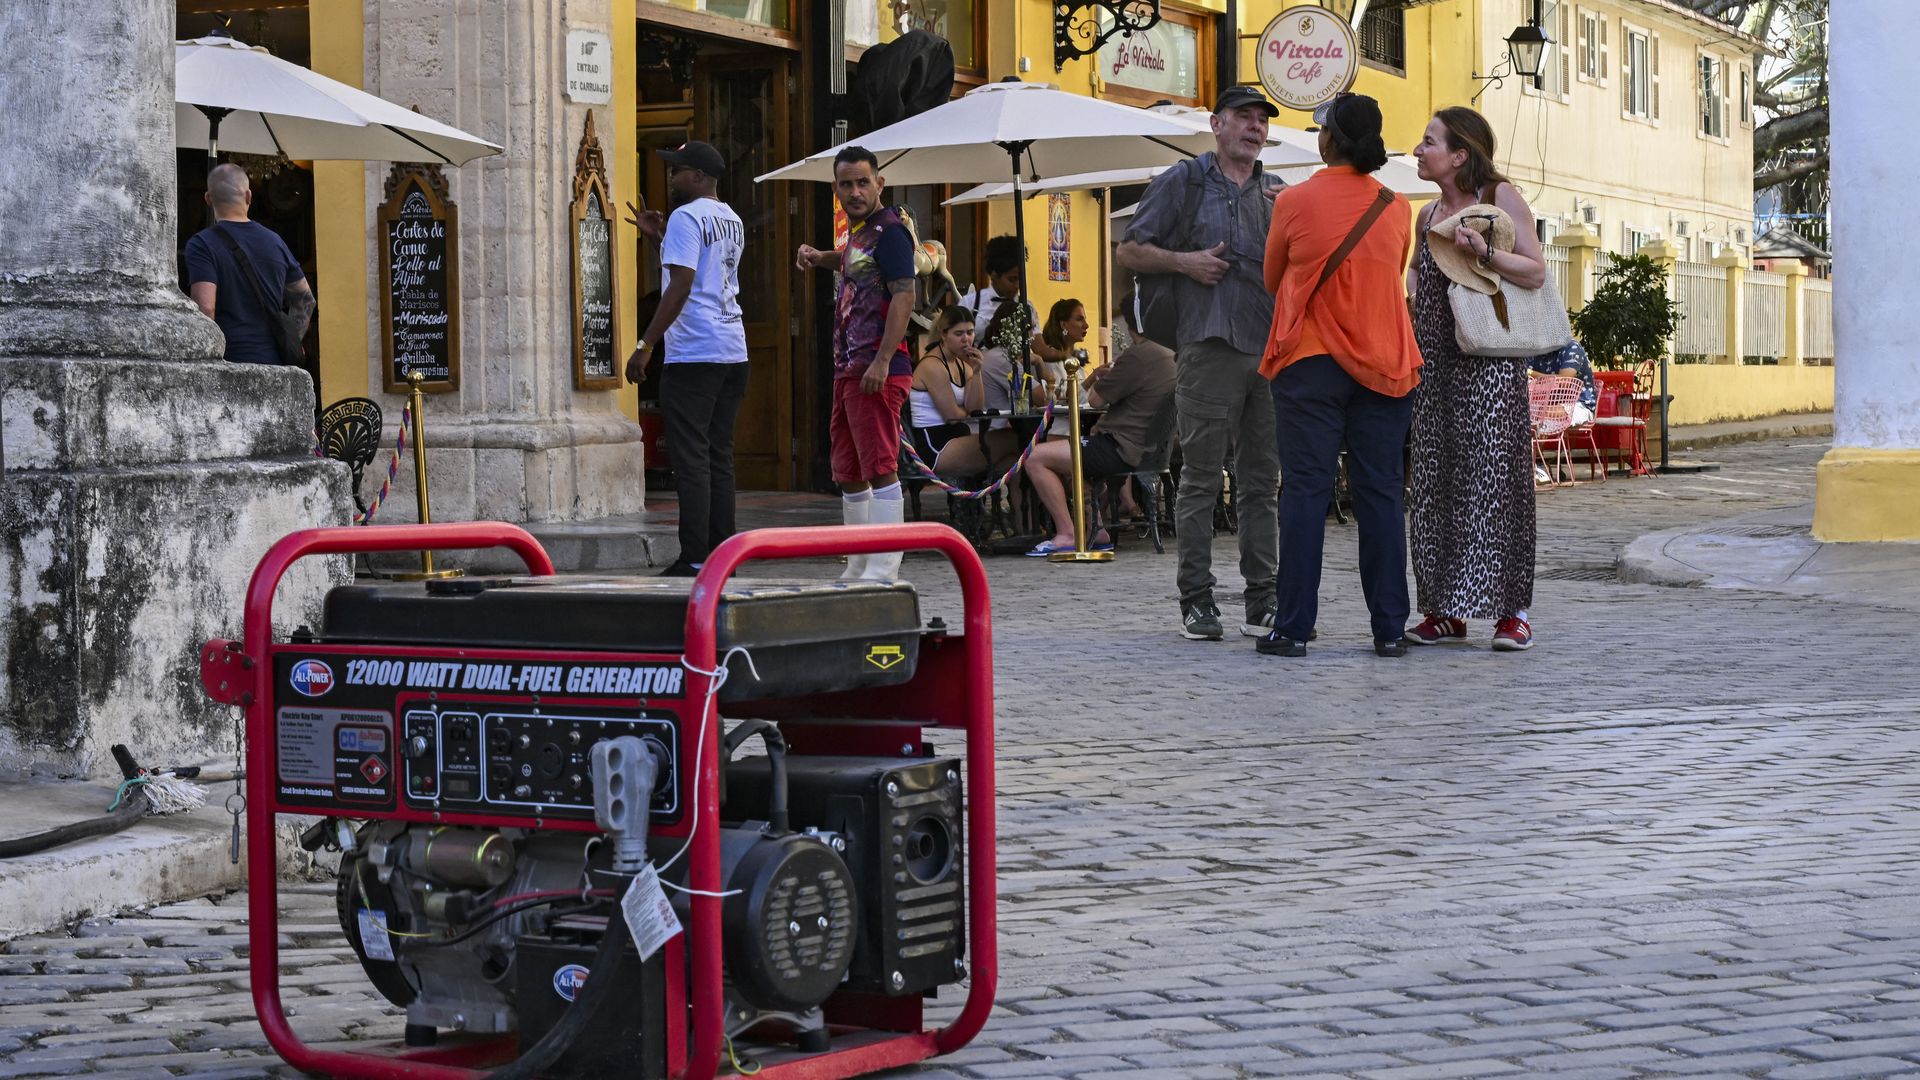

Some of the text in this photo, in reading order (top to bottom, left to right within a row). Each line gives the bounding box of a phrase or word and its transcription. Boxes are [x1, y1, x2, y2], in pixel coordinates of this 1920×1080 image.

[1113, 42, 1165, 75] La Vitrola
[1268, 39, 1343, 60] Vitrola
[1287, 61, 1323, 84] Café
[570, 80, 577, 90] DE
[1267, 72, 1343, 104] SWEETS AND COFFEE
[431, 220, 445, 238] de
[428, 255, 442, 271] al
[428, 289, 439, 299] de
[399, 300, 440, 309] Mariscos
[294, 669, 330, 684] ALL-POWER
[345, 659, 684, 694] 12000 WATT DUAL-FUEL GENERATOR
[340, 730, 357, 748] CO
